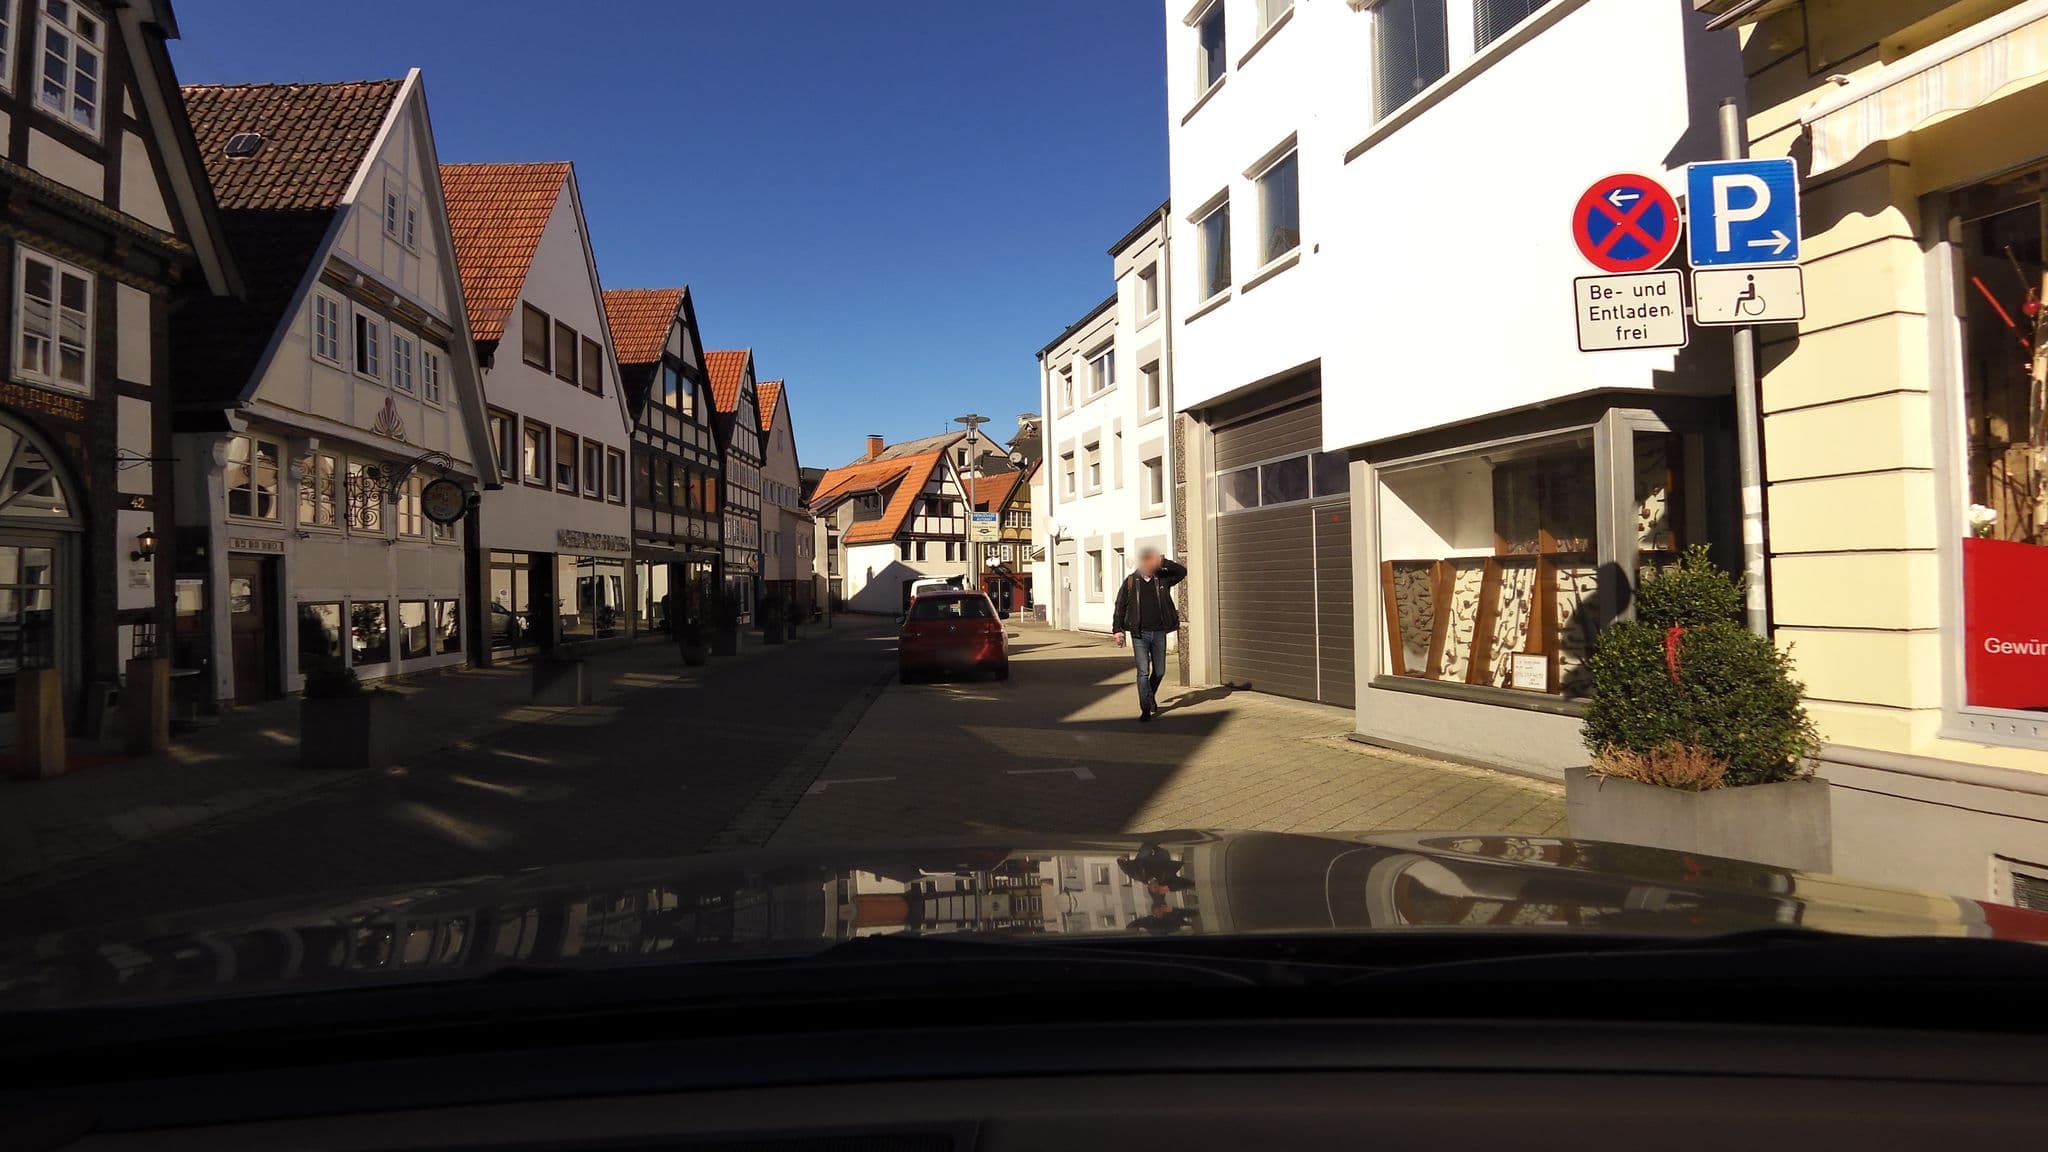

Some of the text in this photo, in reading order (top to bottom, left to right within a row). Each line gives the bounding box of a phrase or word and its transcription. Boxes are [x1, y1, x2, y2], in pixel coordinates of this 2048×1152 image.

[1712, 174, 1770, 252] P
[1590, 281, 1666, 300] Be- und
[1589, 303, 1670, 321] Entladen
[1616, 324, 1647, 341] frei
[130, 496, 144, 509] 42
